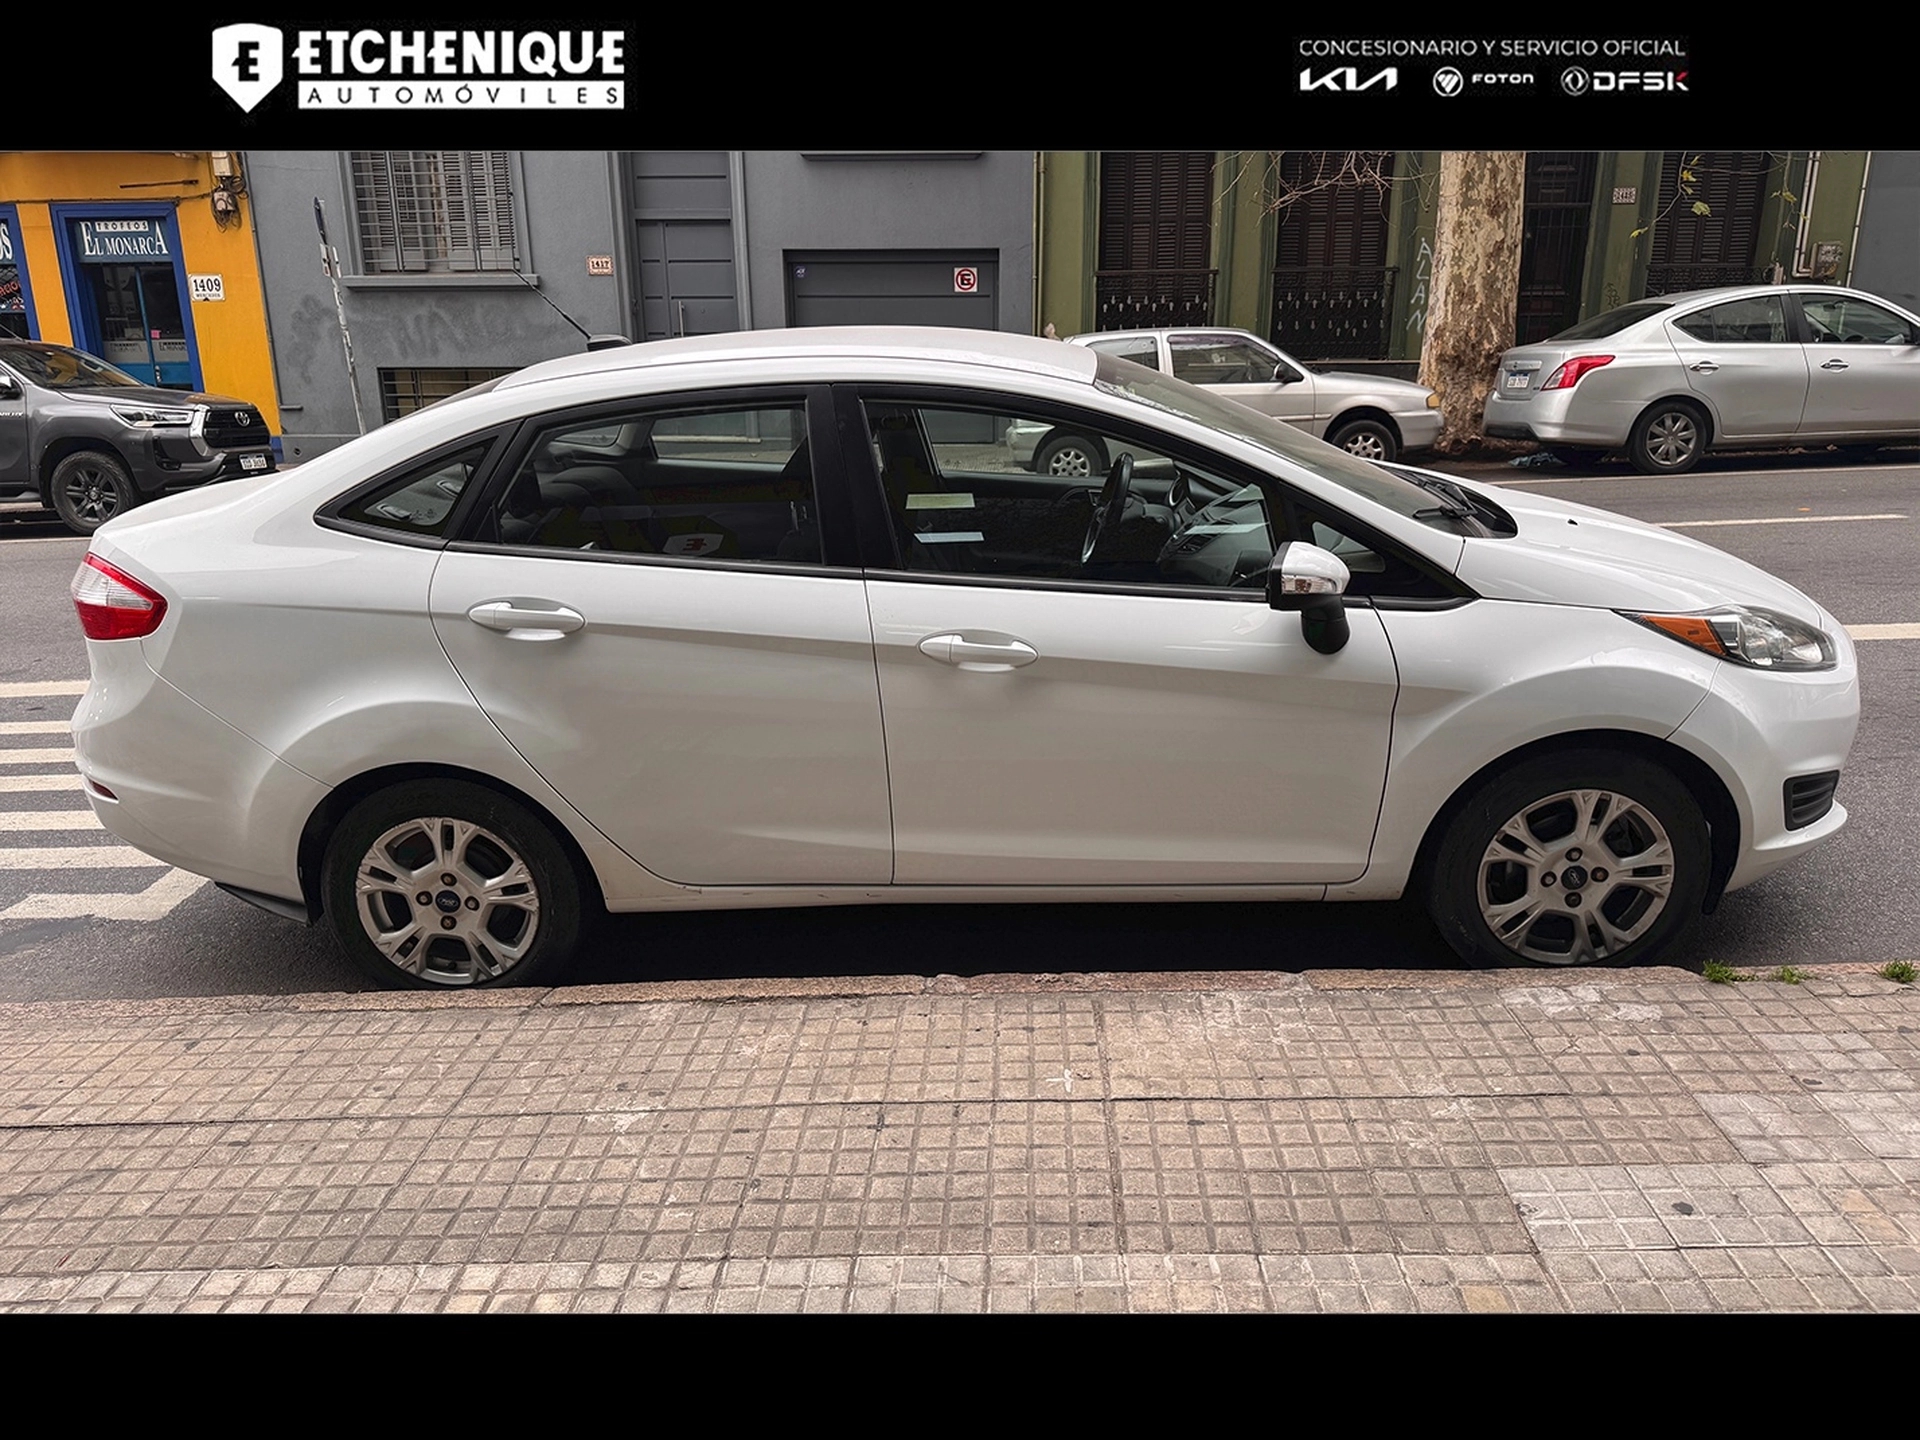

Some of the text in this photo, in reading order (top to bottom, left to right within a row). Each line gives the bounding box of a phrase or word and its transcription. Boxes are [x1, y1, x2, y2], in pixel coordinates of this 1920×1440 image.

[97, 222, 147, 230] TROFEOS
[105, 221, 168, 255] MONARCA
[193, 278, 221, 292] 1409
